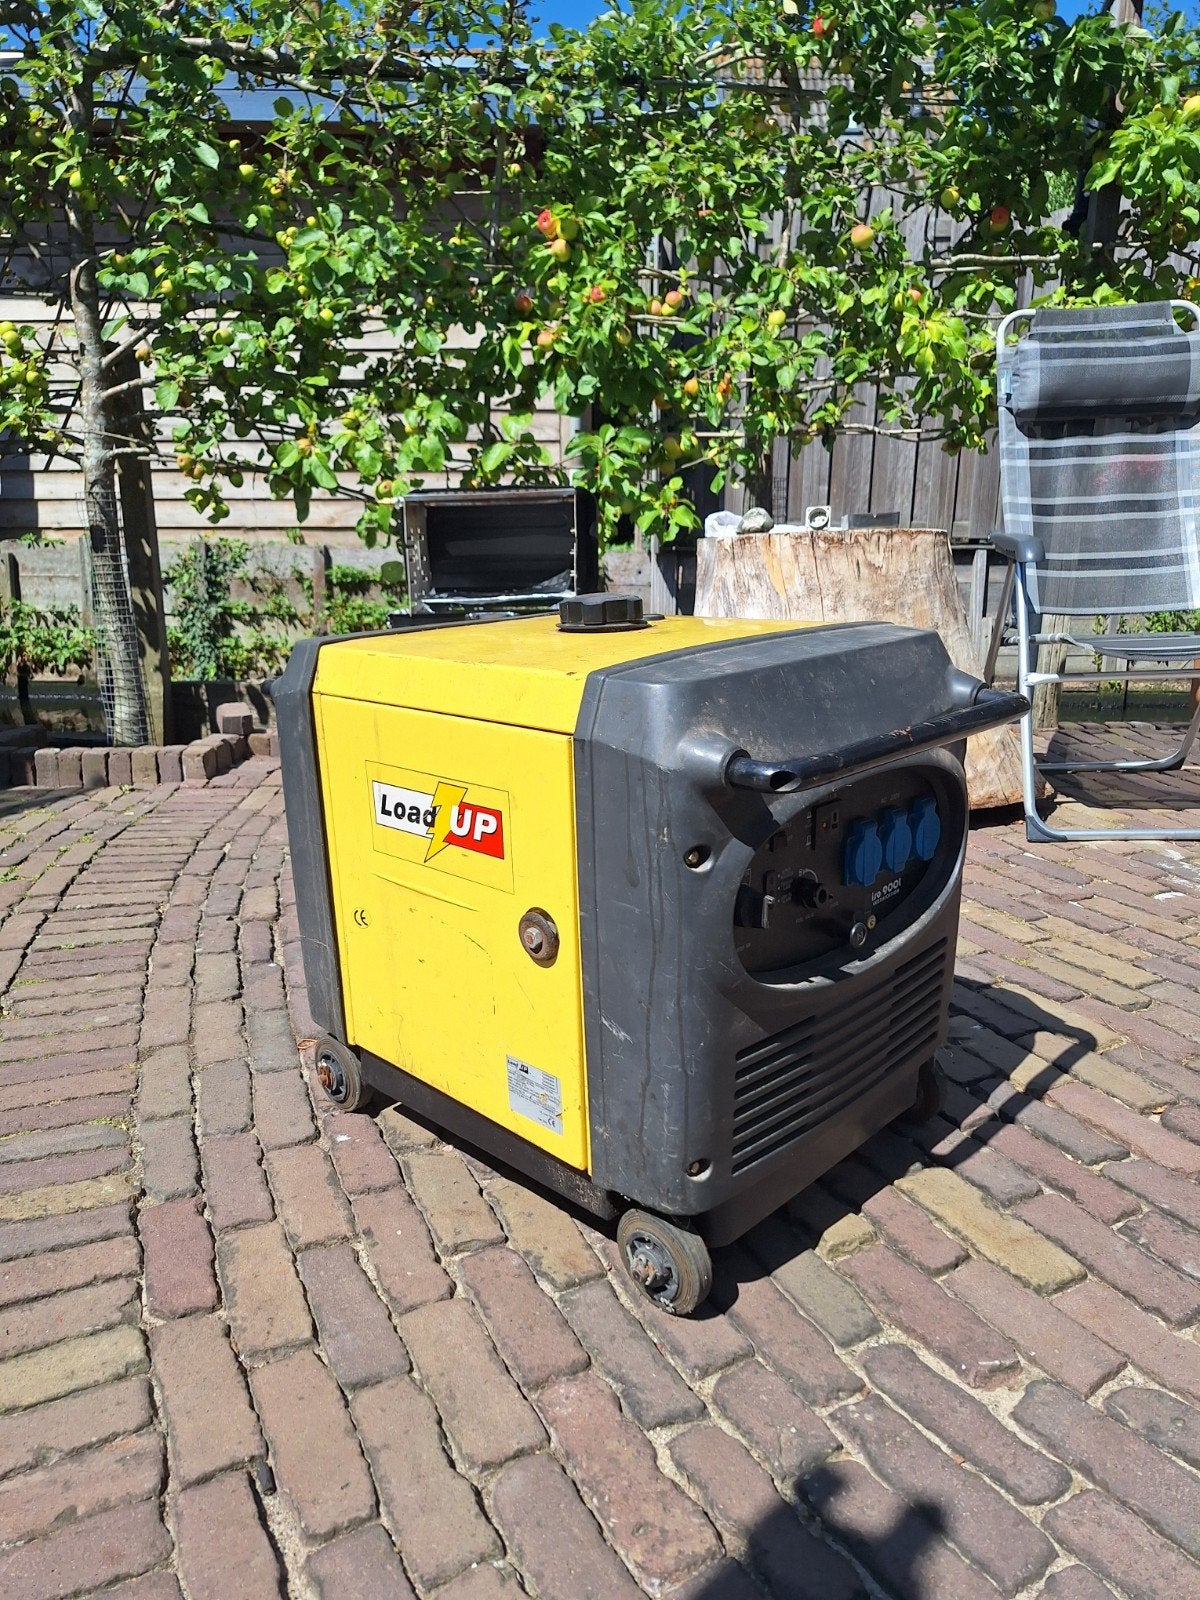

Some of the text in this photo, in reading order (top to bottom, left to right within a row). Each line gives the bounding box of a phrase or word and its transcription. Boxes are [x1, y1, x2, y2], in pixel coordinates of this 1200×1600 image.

[381, 794, 498, 841] Load UP
[354, 909, 369, 926] CE
